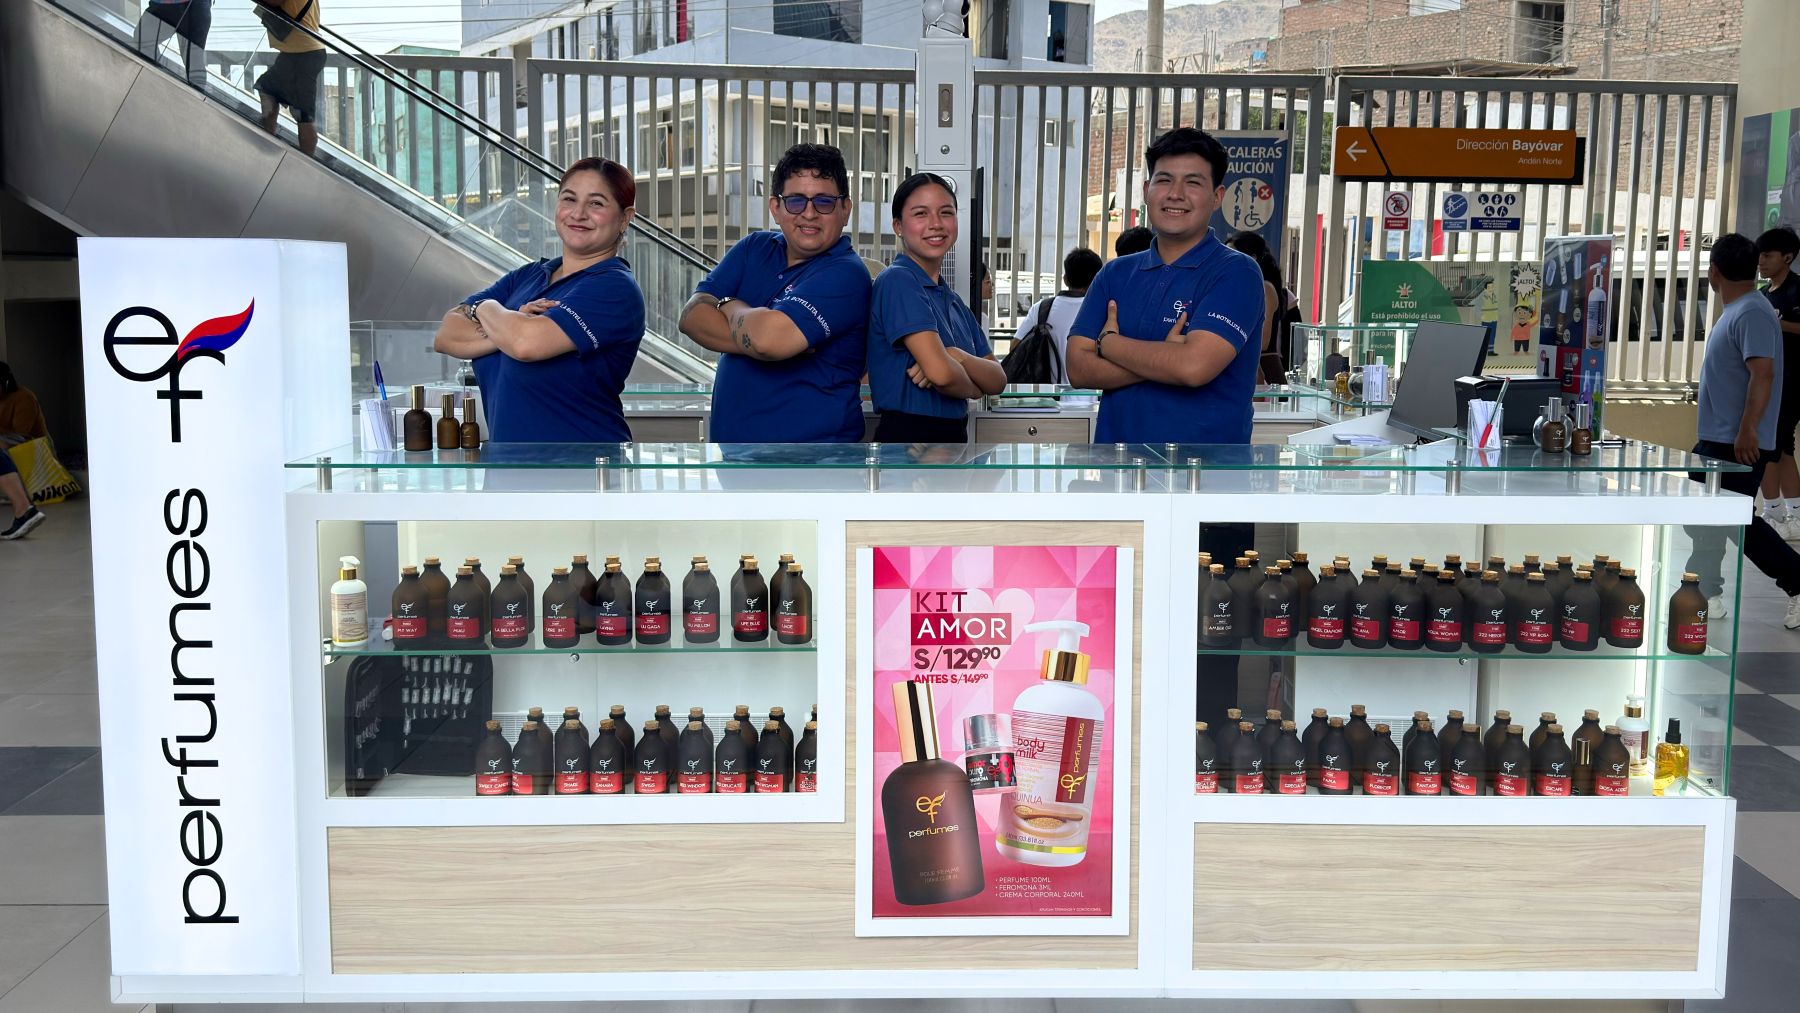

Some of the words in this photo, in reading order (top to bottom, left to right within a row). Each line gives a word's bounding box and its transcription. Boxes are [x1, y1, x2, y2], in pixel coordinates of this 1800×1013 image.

[1224, 146, 1282, 158] CALERAS
[1457, 139, 1509, 150] Dirección
[1512, 140, 1564, 152] Bayóvar
[1226, 159, 1274, 174] AUCIÓN
[566, 308, 587, 331] BOTELLITA
[1216, 314, 1240, 331] BOTELLITA
[32, 481, 78, 502] Nikon
[916, 592, 967, 612] KIT
[917, 618, 1007, 639] AMOR
[913, 674, 948, 683] ANTES
[162, 488, 239, 925] perfumes
[1018, 734, 1045, 752] body
[1073, 722, 1085, 773] perfumes
[1016, 748, 1037, 759] milk
[909, 824, 959, 838] perfumes
